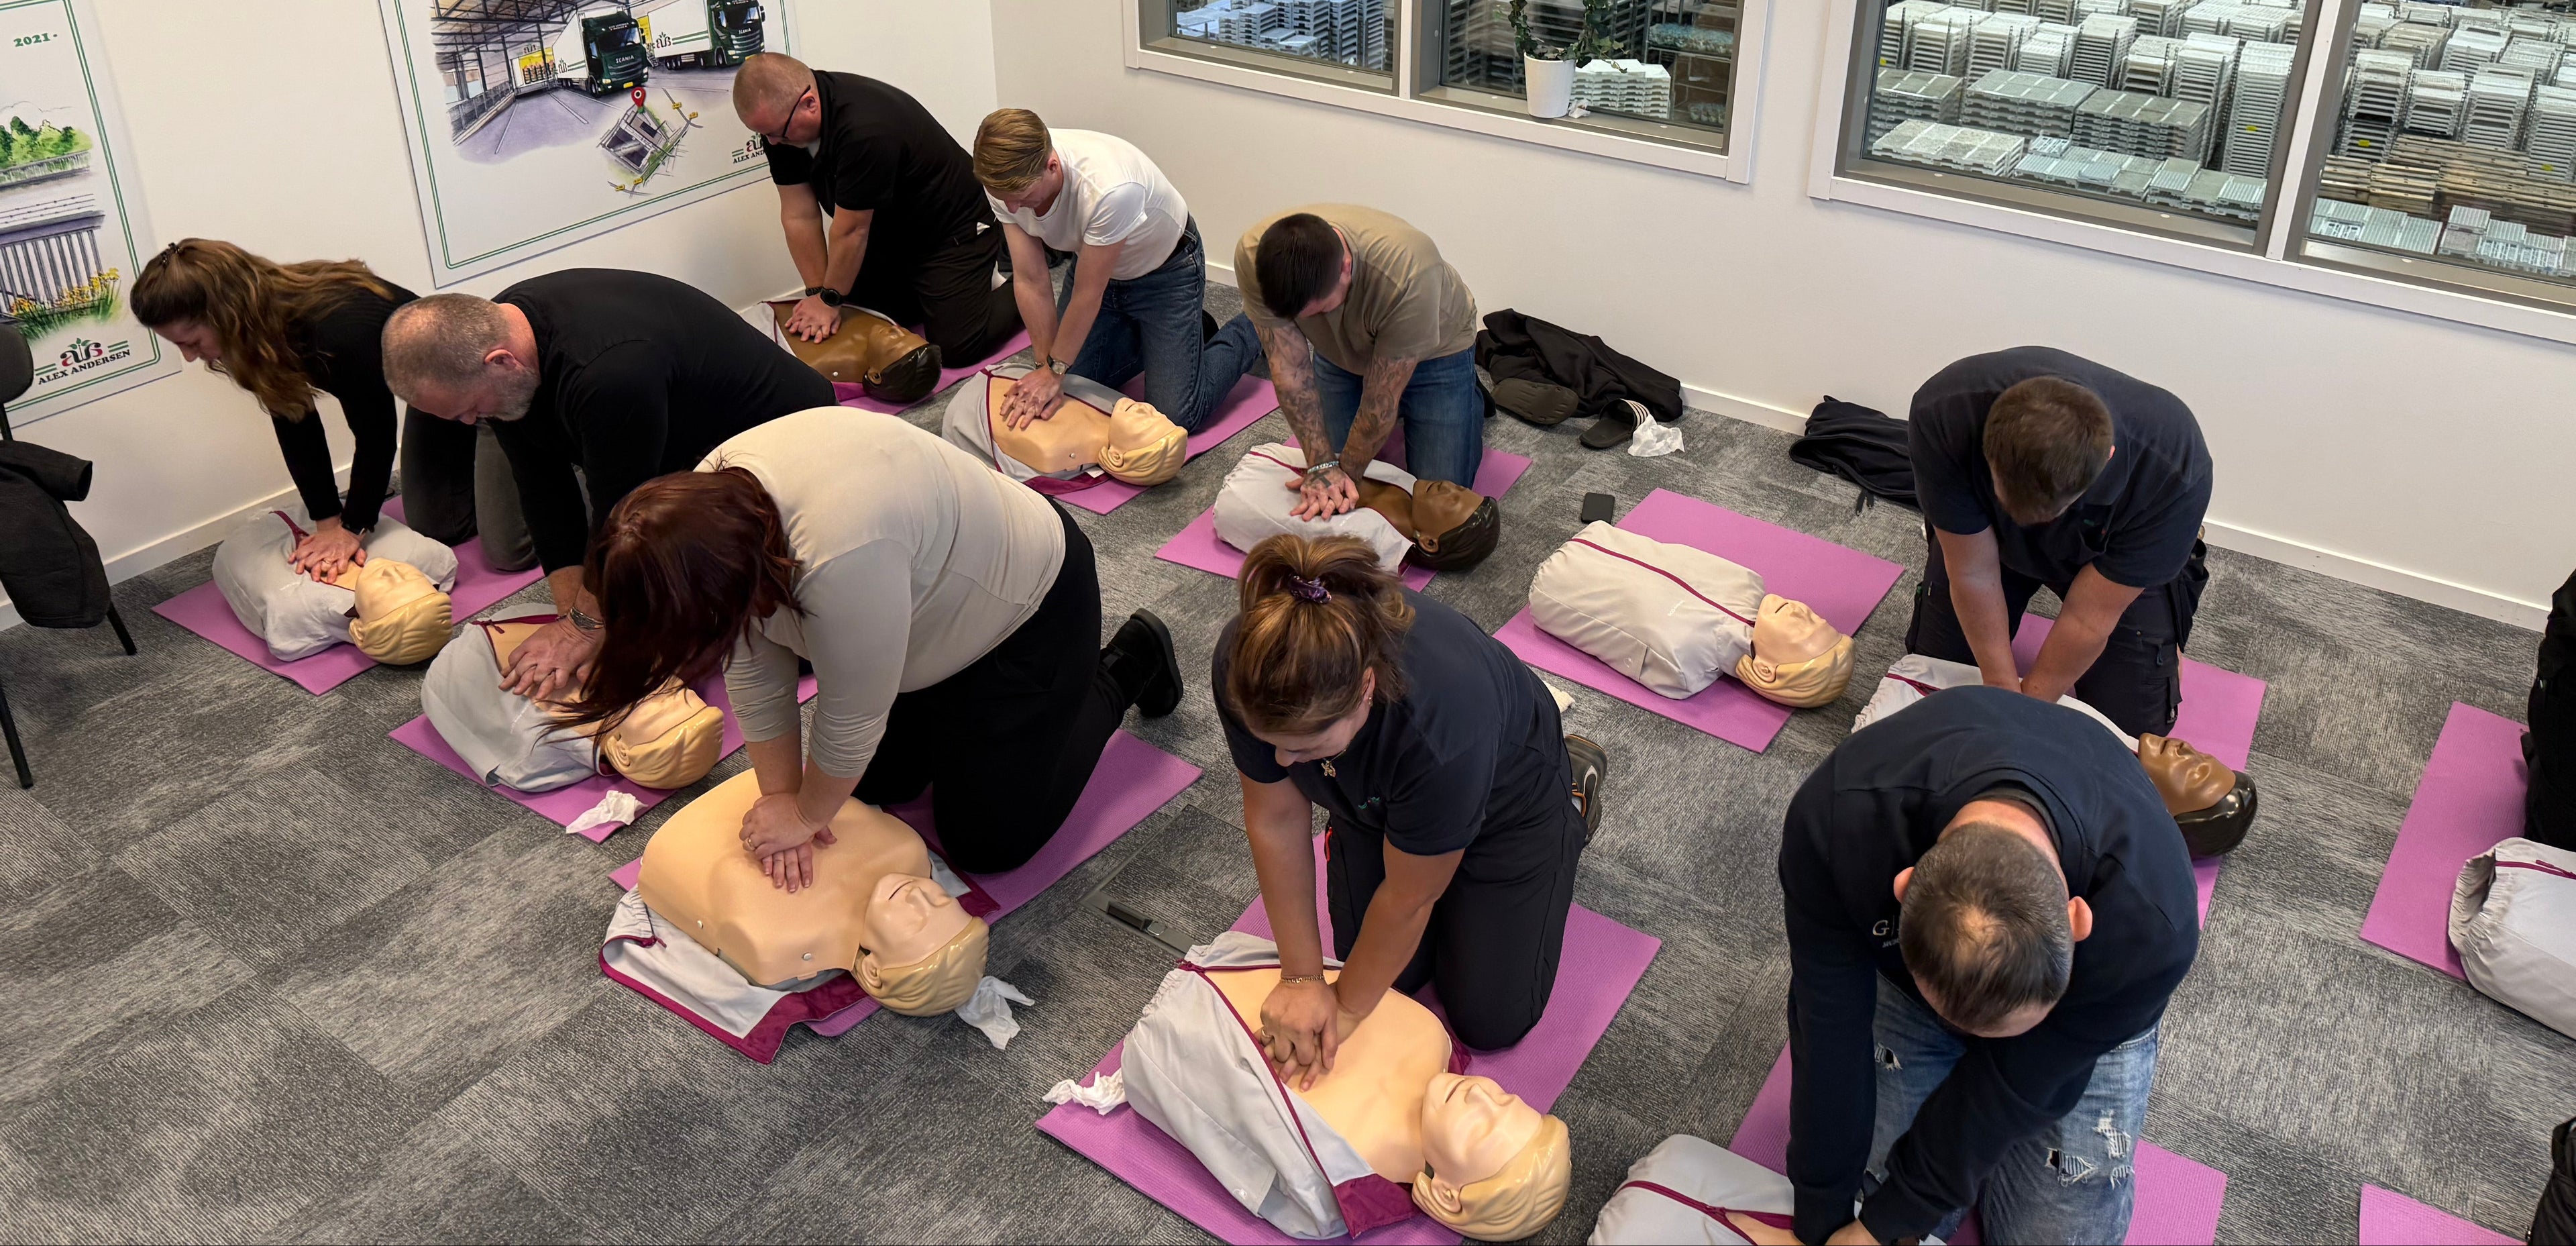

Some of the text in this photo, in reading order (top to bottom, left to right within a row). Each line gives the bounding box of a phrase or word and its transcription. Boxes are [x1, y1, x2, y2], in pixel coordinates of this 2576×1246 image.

[615, 54, 635, 64] SCANIA
[733, 154, 750, 164] ALEX
[38, 349, 131, 385] ALEX ANDERSEN
